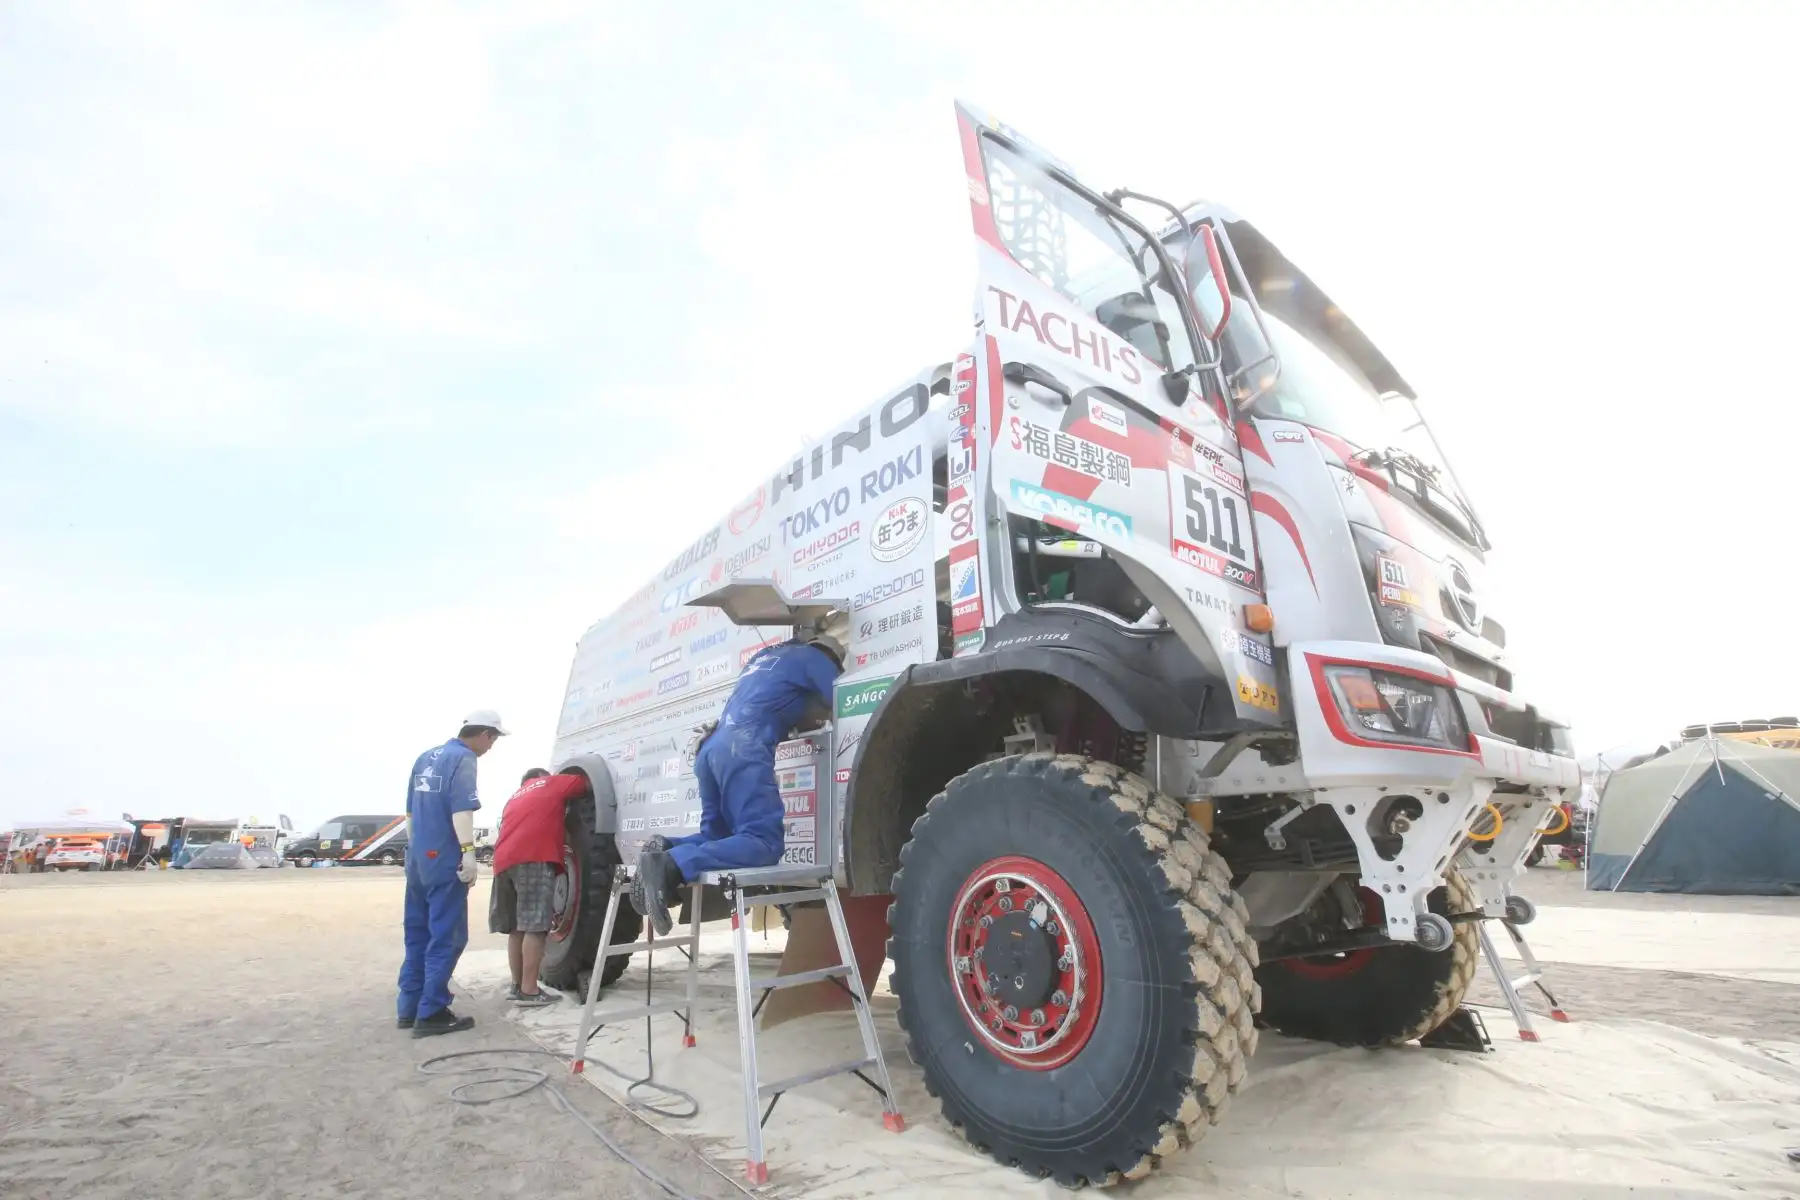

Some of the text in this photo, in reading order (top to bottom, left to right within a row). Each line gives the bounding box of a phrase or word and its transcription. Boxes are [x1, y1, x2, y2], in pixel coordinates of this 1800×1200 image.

[771, 383, 930, 507] HINO
[1022, 420, 1131, 487] 福島製鋼
[779, 444, 922, 547] TOKYO ROKI
[878, 511, 918, 545] 缶つま
[1183, 474, 1246, 561] 511
[662, 525, 722, 581] CATALER
[724, 533, 772, 575] IDEMITSU
[792, 521, 860, 564] CHIYODA
[823, 569, 856, 589] TRUCKS
[1177, 545, 1255, 585] MOTUL 300V
[1384, 559, 1406, 586] 511
[1184, 587, 1237, 617] TAKATA
